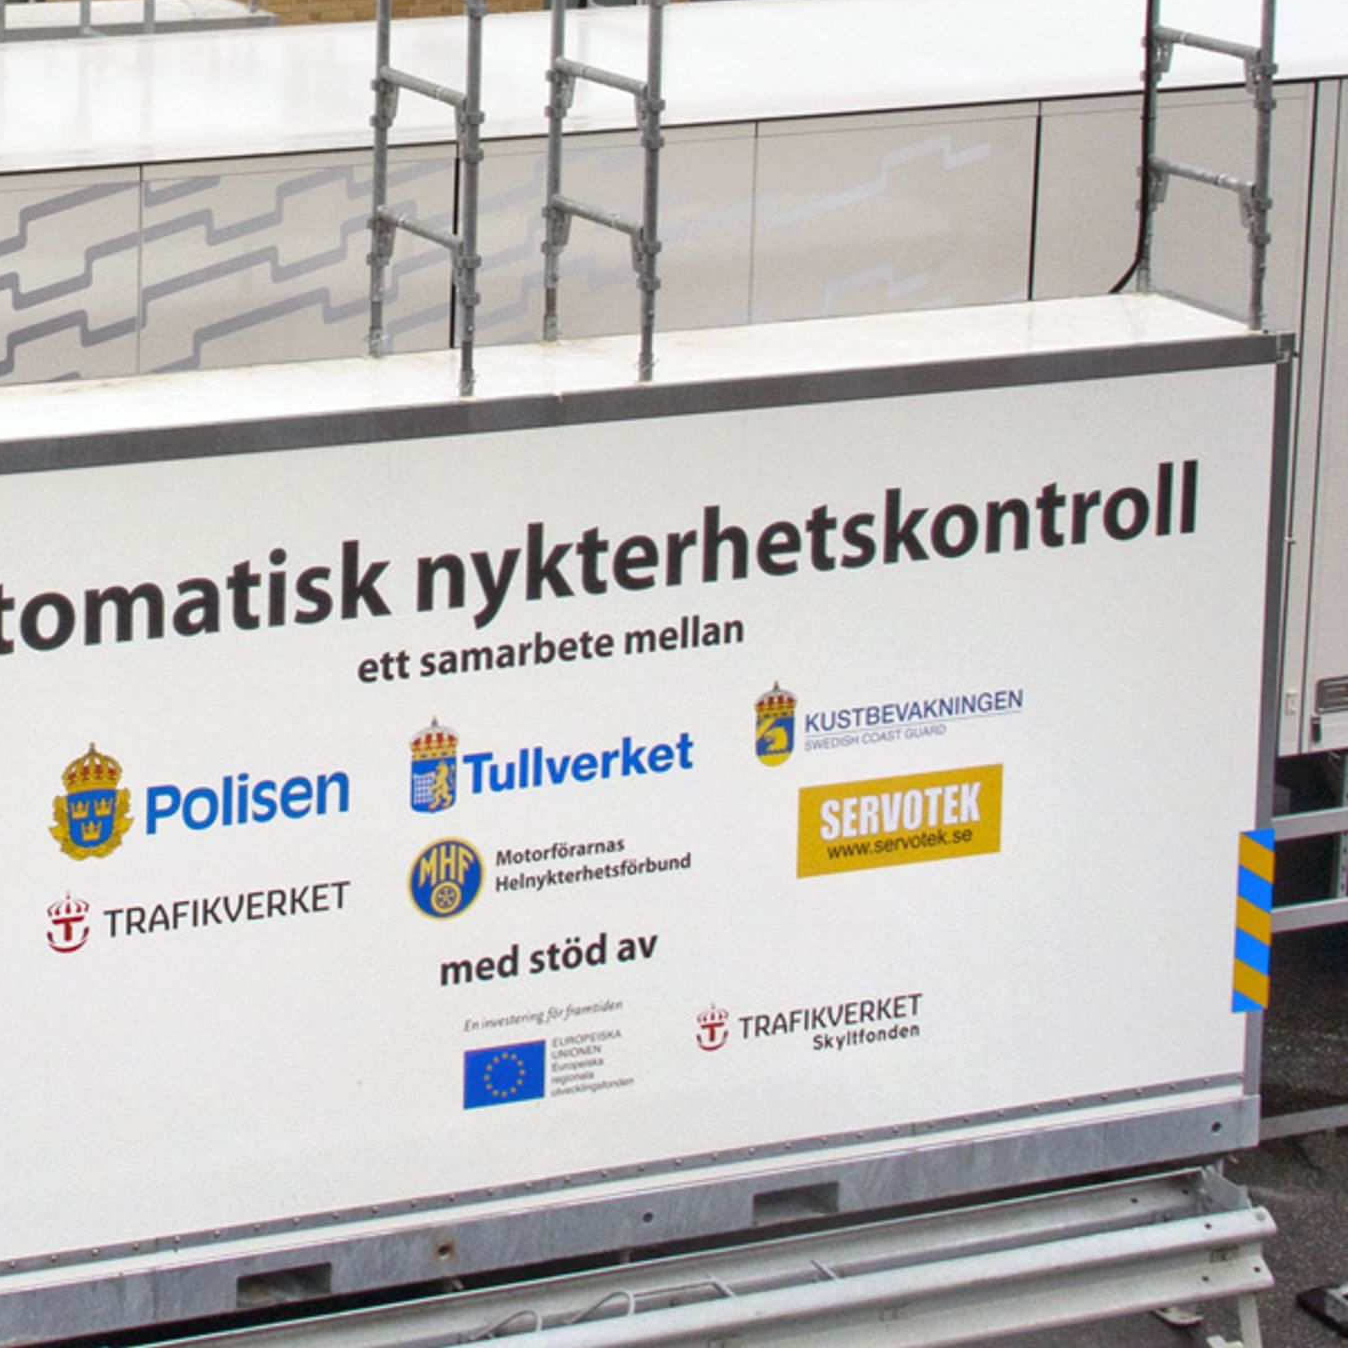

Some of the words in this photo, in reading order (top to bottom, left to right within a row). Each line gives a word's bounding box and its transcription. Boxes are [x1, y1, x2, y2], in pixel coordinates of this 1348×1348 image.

[417, 459, 1198, 629] nykterhetskontroll
[358, 650, 410, 683] ett
[420, 632, 614, 677] samarbete
[625, 615, 743, 655] mellan
[805, 690, 1023, 732] KUSTBEVAKNINGEN
[805, 733, 859, 751] SWEDISH
[862, 728, 901, 745] COAST
[904, 723, 947, 740] GUARD
[463, 733, 693, 794] Tullverket
[147, 772, 349, 834] Polisen
[820, 782, 981, 841] SERVOTEK
[418, 845, 474, 887] MHF
[496, 839, 625, 866] Motorförarnas
[827, 828, 973, 860] www.servotek.se
[496, 852, 691, 892] Helnykterhetsförbund
[104, 881, 350, 937] TRAFIKVERKET
[441, 944, 518, 986] med
[530, 933, 606, 974] stöd
[617, 935, 657, 962] av
[463, 1018, 479, 1032] En
[481, 1009, 545, 1028] investering
[545, 1005, 564, 1023] för
[563, 999, 623, 1022] framtiden
[739, 993, 922, 1039] TRAFIKVERKET
[813, 1025, 920, 1050] Skyltfonden
